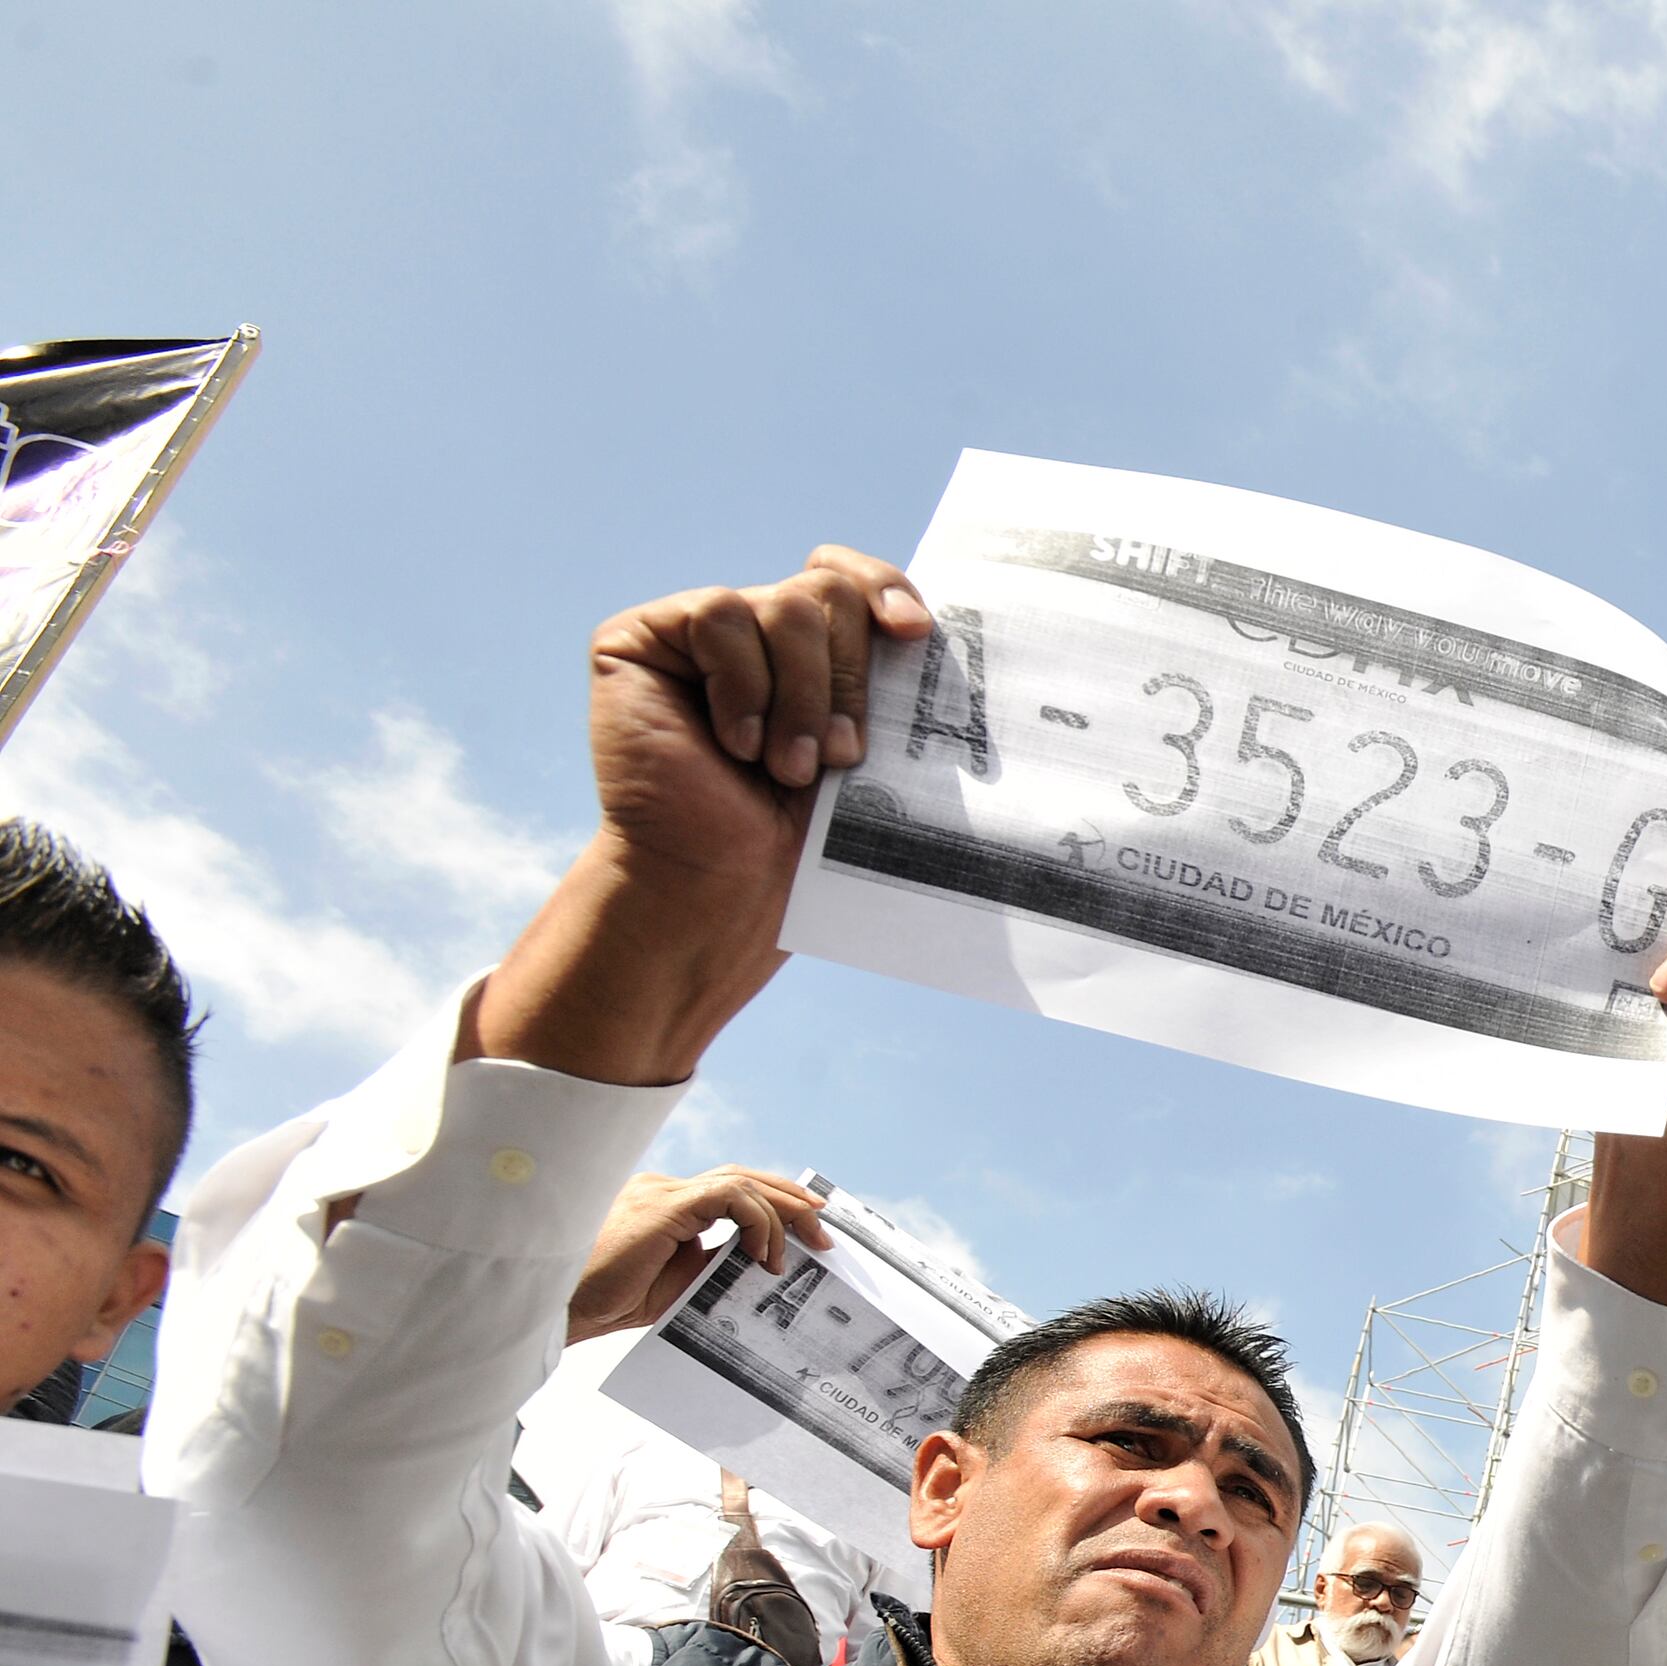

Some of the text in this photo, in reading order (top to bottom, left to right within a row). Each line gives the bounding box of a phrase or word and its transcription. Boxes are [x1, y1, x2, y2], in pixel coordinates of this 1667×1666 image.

[1283, 661, 1407, 704] CIUDAD DE MÉXICO
[1117, 845, 1253, 902] CIUDAD
[1264, 886, 1313, 919] DE
[1321, 902, 1452, 959] MÉXICO
[819, 1381, 880, 1424] CIUDAD
